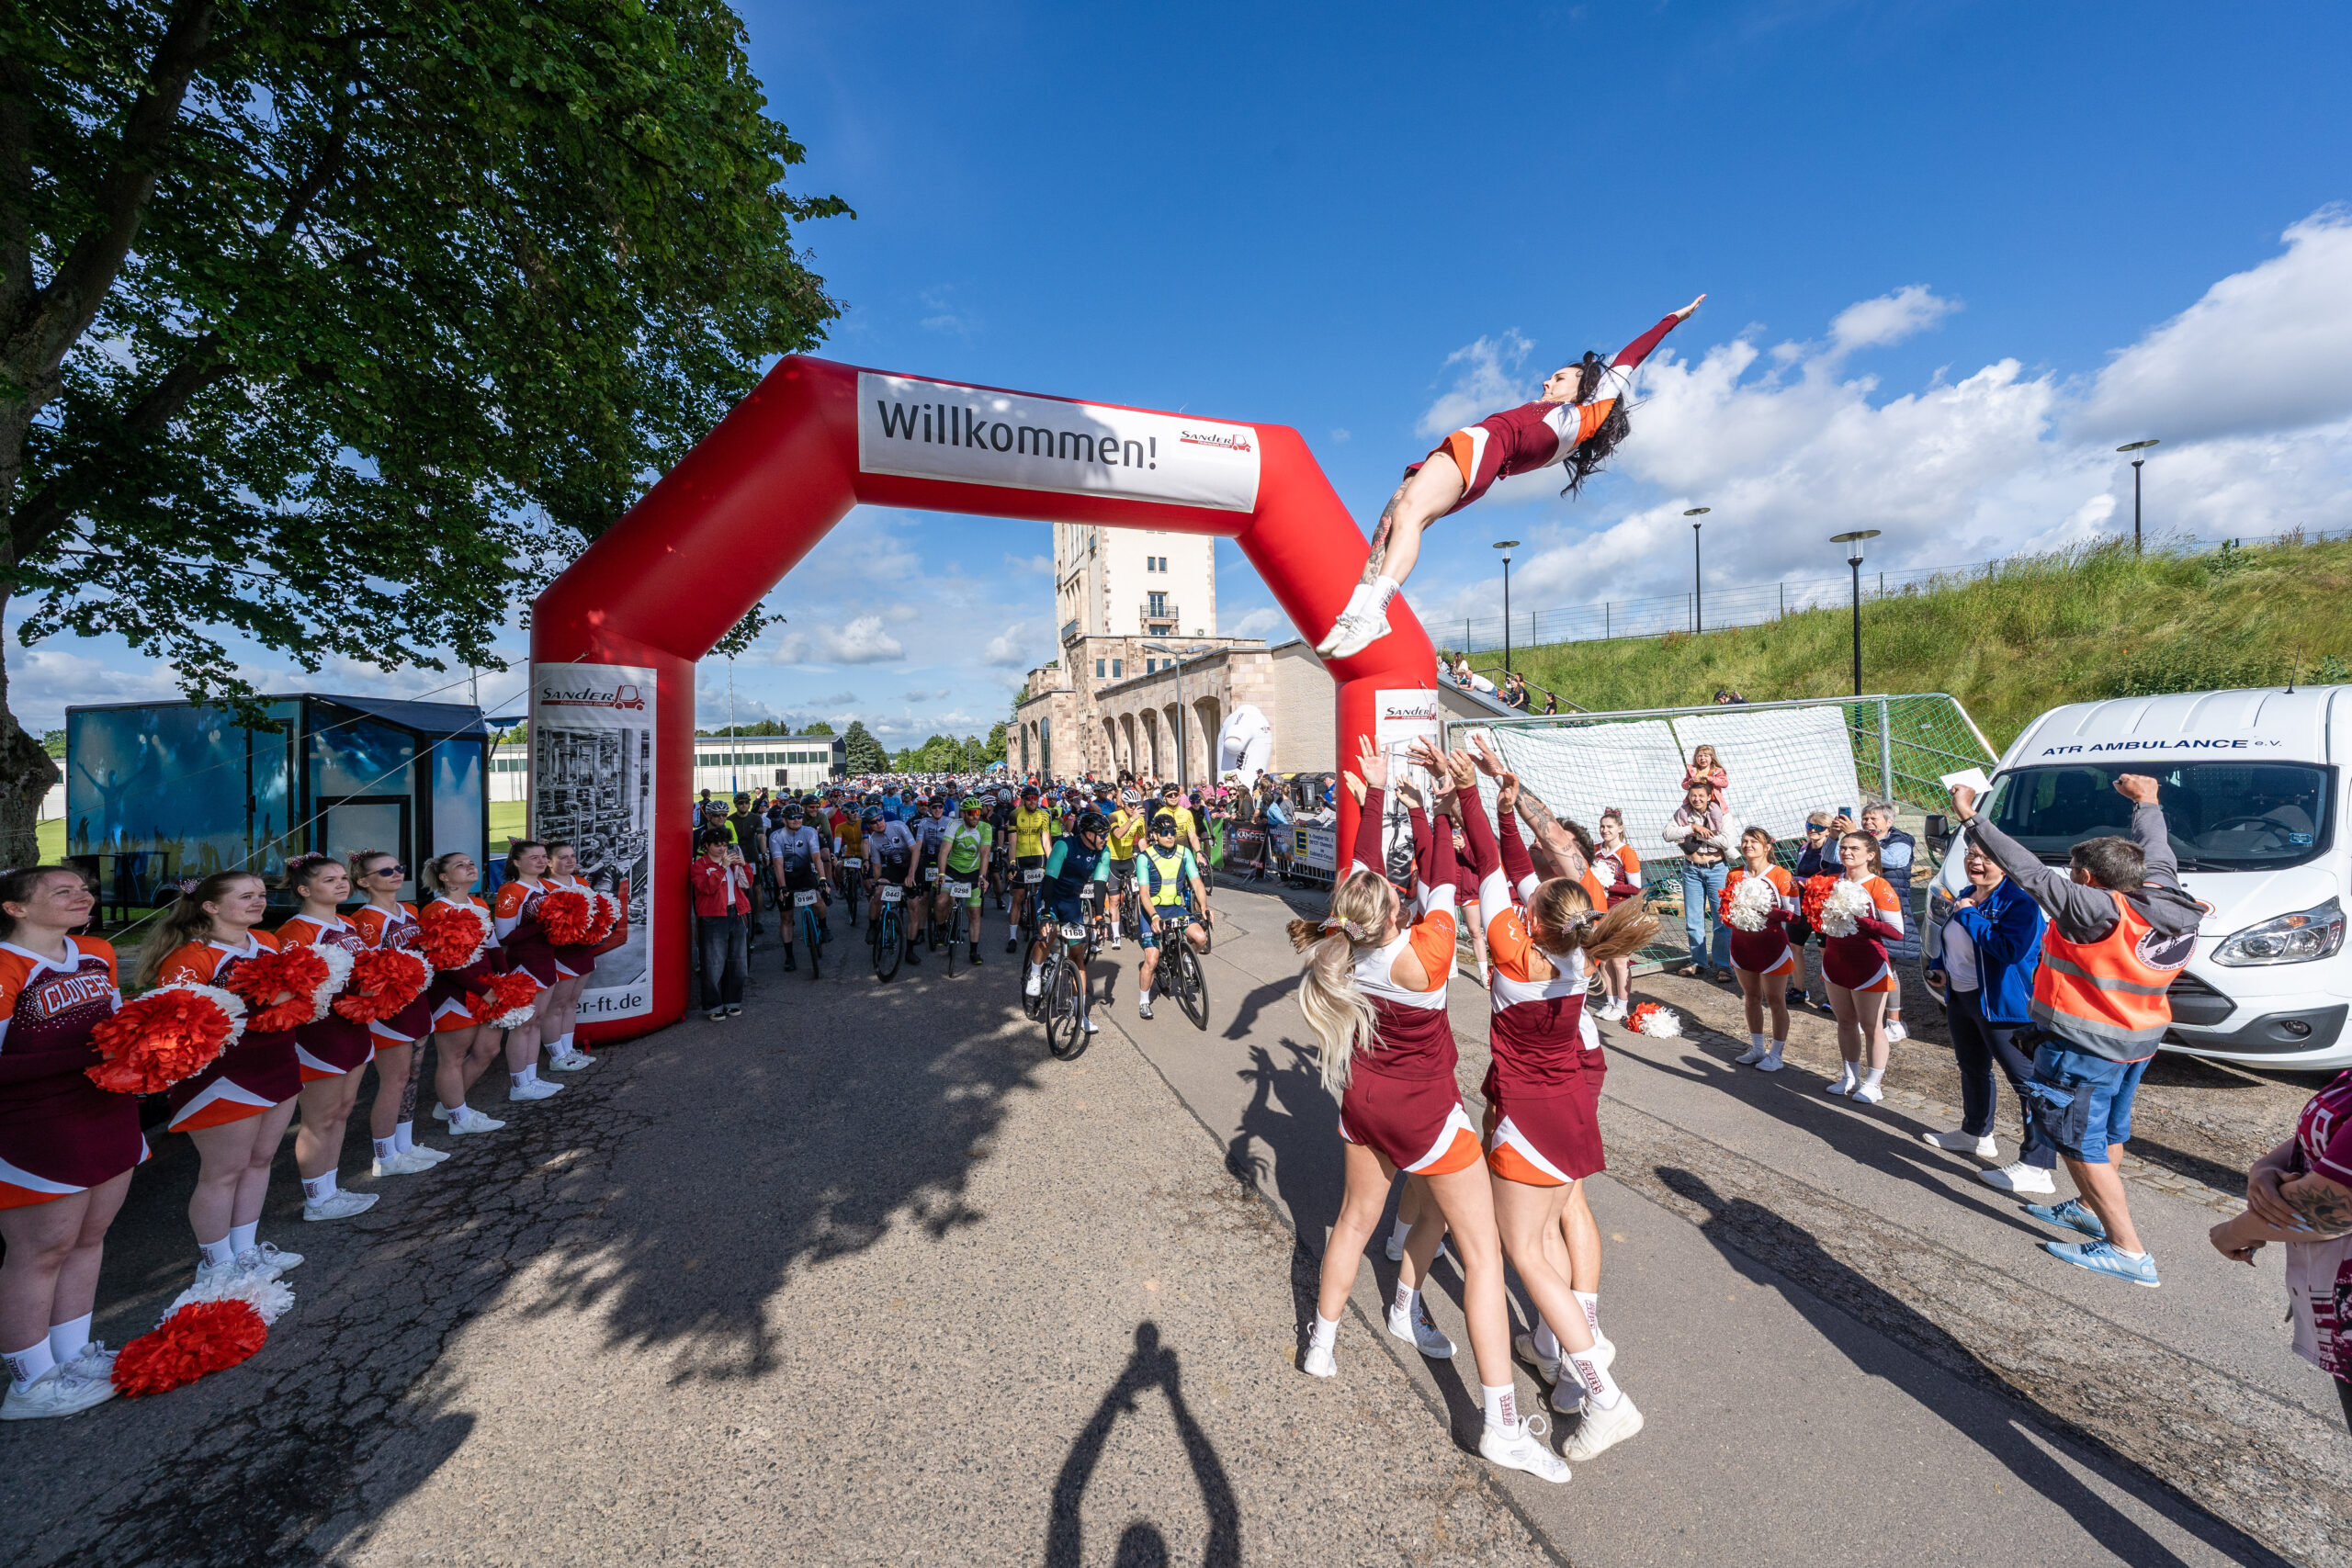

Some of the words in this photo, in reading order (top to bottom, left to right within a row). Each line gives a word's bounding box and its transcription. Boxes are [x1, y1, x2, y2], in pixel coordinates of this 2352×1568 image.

[876, 400, 1157, 470] Willkommen!
[1236, 751, 1245, 771] KTM
[2041, 746, 2083, 757] ATR
[2088, 739, 2249, 752] AMBULANCE
[42, 974, 112, 1014] CLOVERS
[575, 993, 642, 1013] er-ft.de
[1575, 1359, 1605, 1395] CLOVERS
